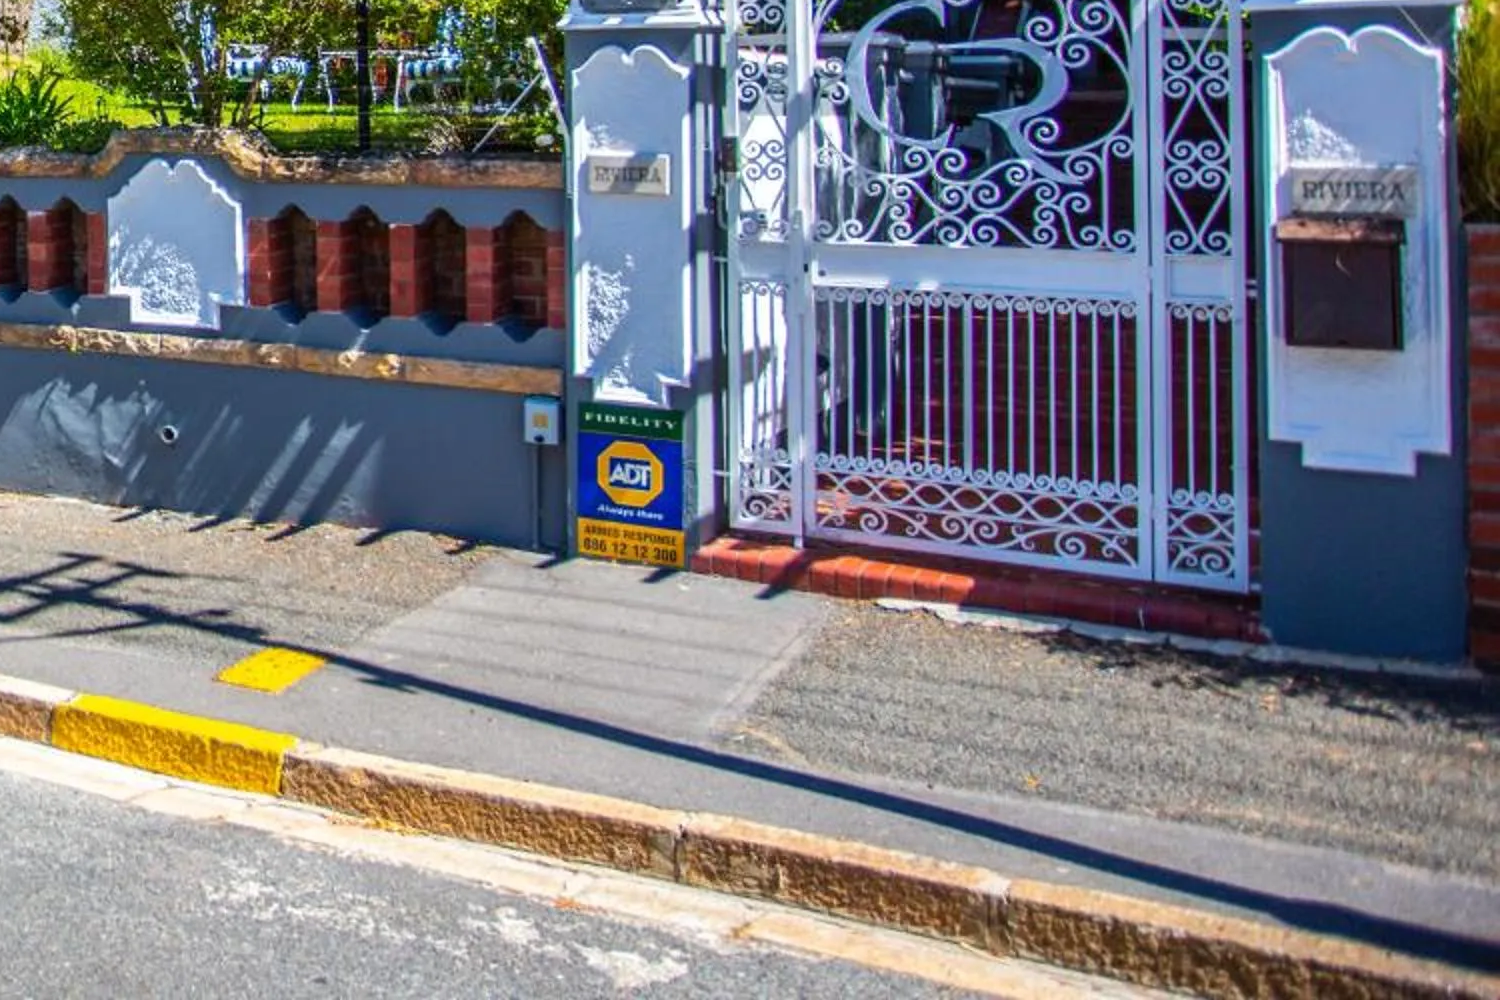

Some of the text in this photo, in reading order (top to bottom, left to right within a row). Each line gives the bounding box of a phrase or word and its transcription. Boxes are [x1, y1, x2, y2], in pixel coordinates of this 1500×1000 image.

[594, 166, 661, 182] RIVIERA
[1302, 181, 1405, 200] RIVIERA
[585, 412, 677, 429] FIDELITY
[610, 463, 652, 487] ADT
[597, 504, 663, 520] Always there
[584, 523, 677, 546] ARMED RESPONSE
[612, 543, 627, 555] 12
[633, 546, 648, 558] 12
